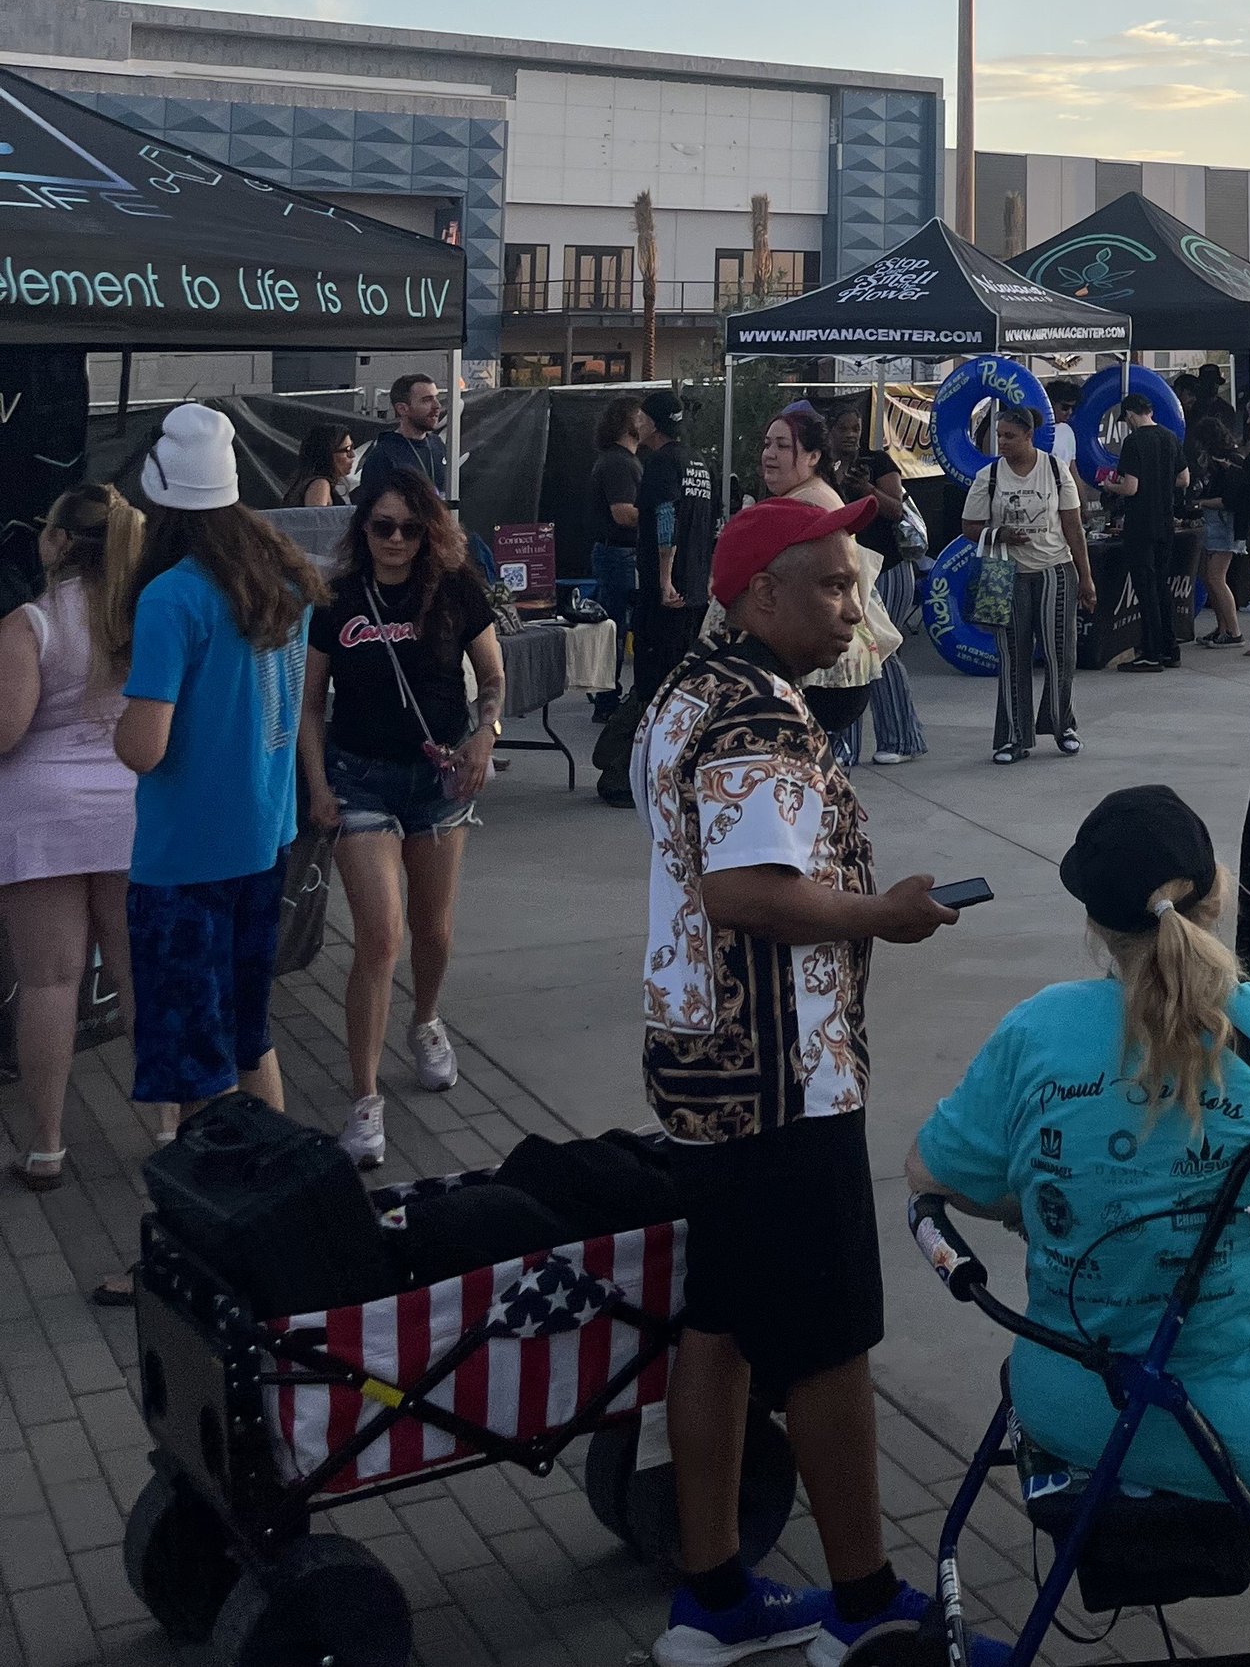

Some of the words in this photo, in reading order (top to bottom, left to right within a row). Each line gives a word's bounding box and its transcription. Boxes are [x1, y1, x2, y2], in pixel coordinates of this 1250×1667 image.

[874, 257, 930, 274] Stop
[0, 257, 164, 308] lement
[182, 265, 220, 309] to
[239, 267, 299, 311] Life
[317, 272, 341, 313] is
[358, 273, 388, 315] to
[854, 271, 939, 291] Smell
[837, 287, 930, 303] Flower
[739, 328, 983, 343] WWW.NIRVANACENTER.COM
[1005, 326, 1126, 342] WWW.NIRVANACENTER.COM
[979, 360, 1025, 404] Pucks
[924, 577, 955, 645] Pucks
[1028, 1072, 1105, 1114] Proud
